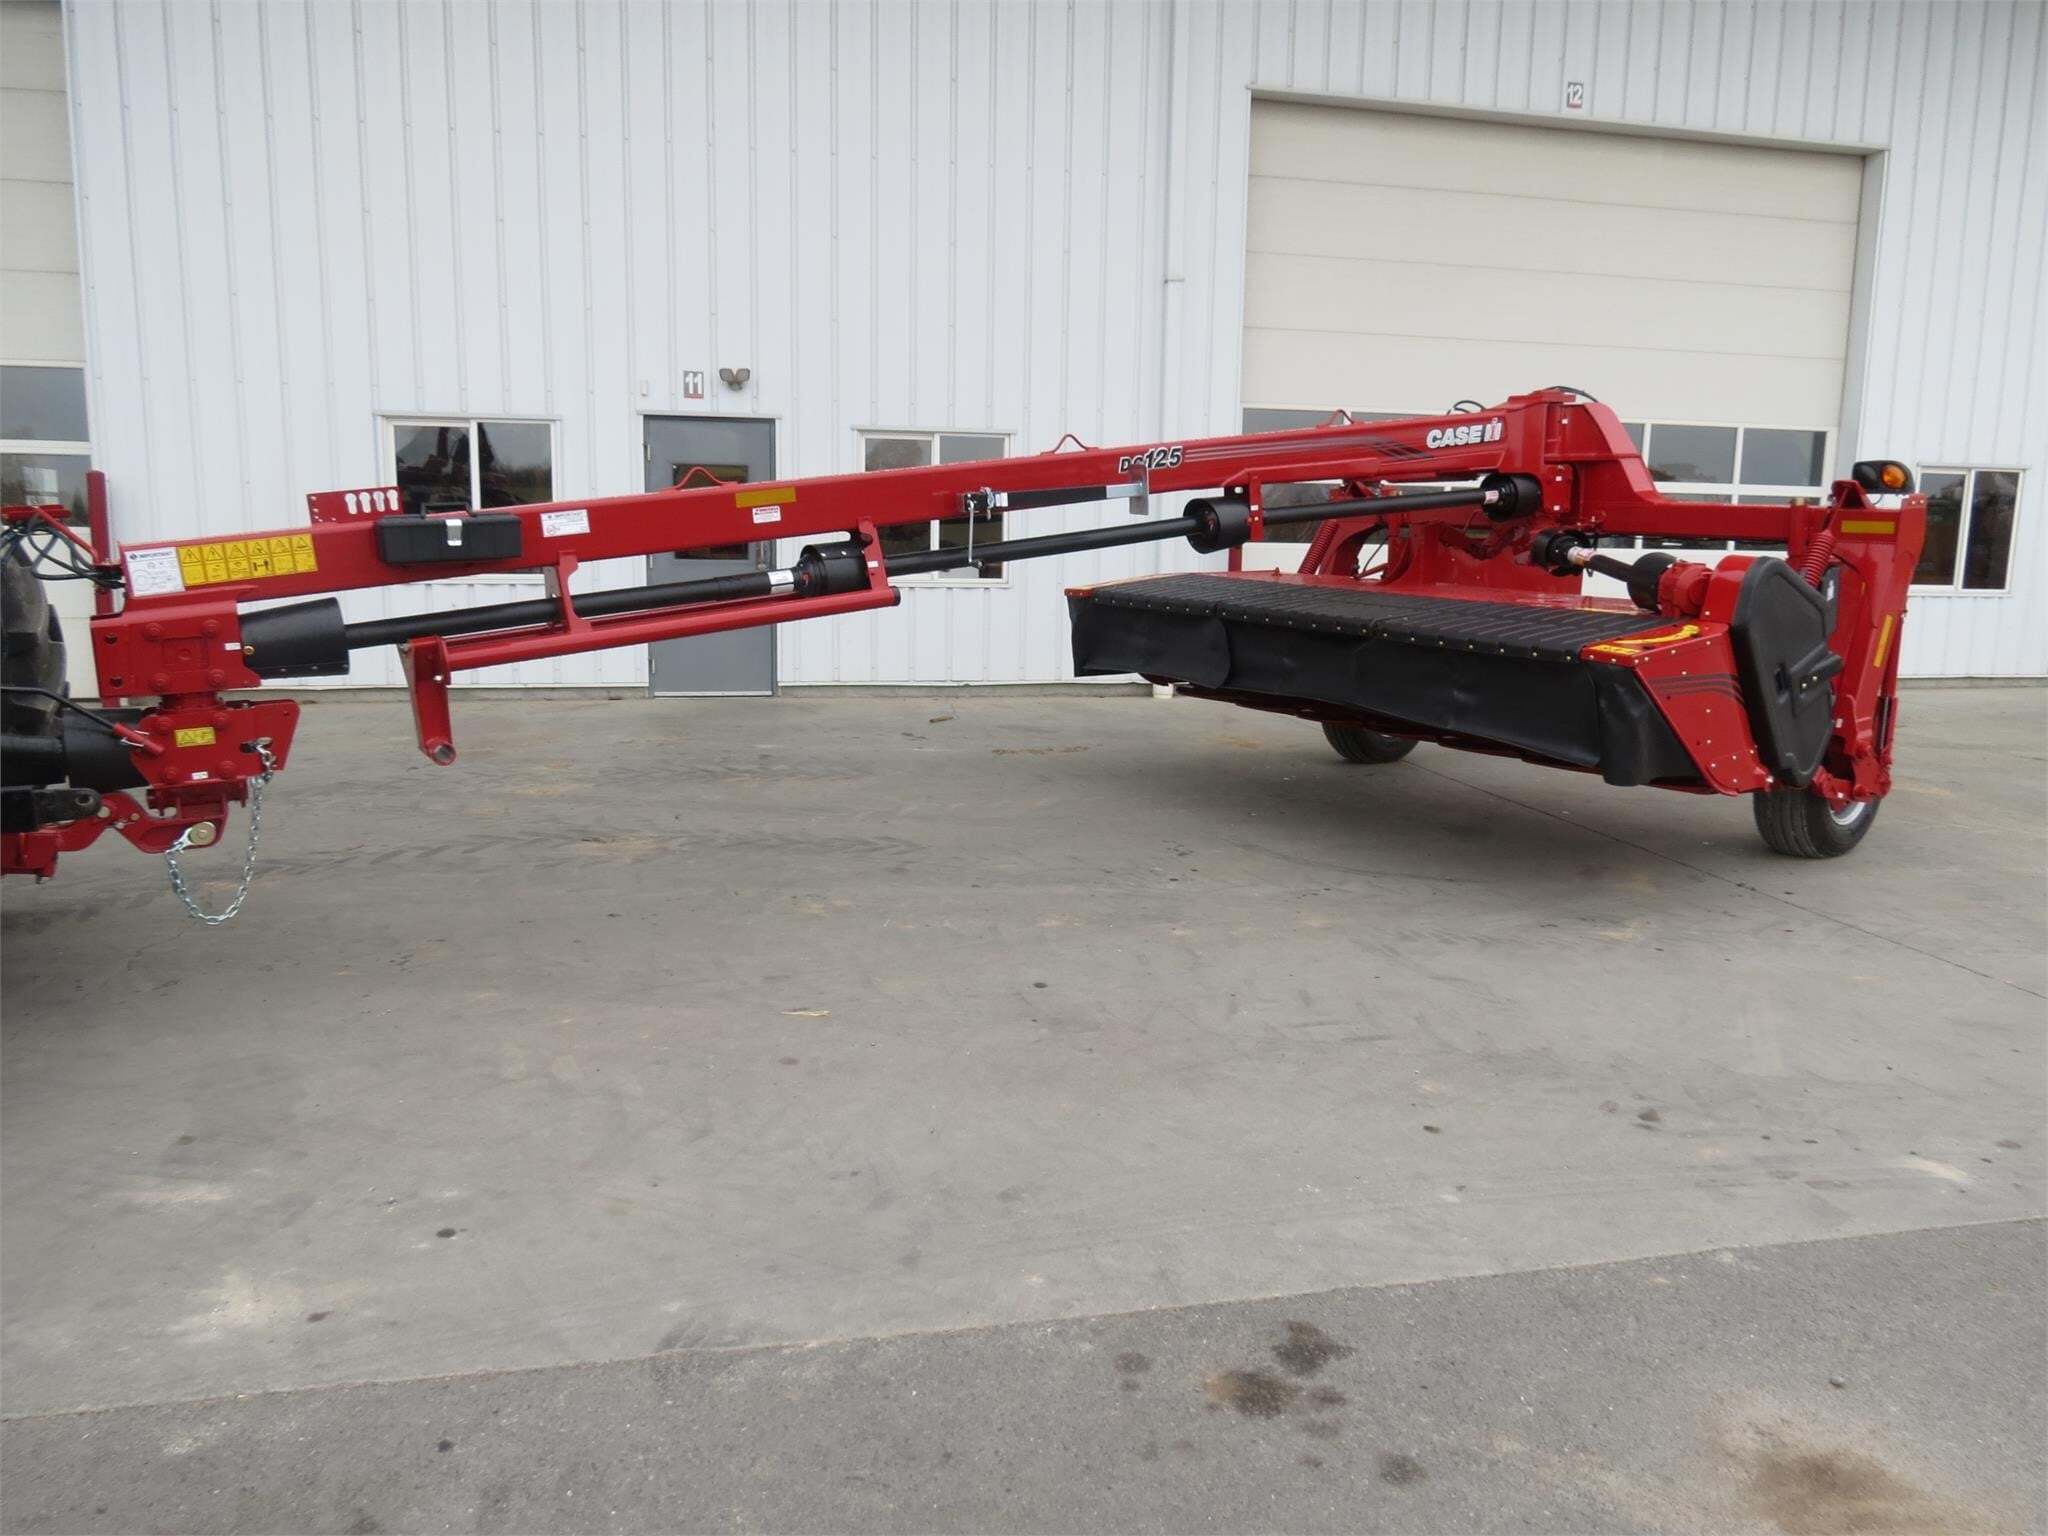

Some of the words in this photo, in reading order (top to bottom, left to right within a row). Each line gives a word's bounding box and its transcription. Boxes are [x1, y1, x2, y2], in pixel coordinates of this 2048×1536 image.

[1568, 84, 1582, 105] 12
[685, 372, 703, 394] 11
[1426, 425, 1482, 448] CASE
